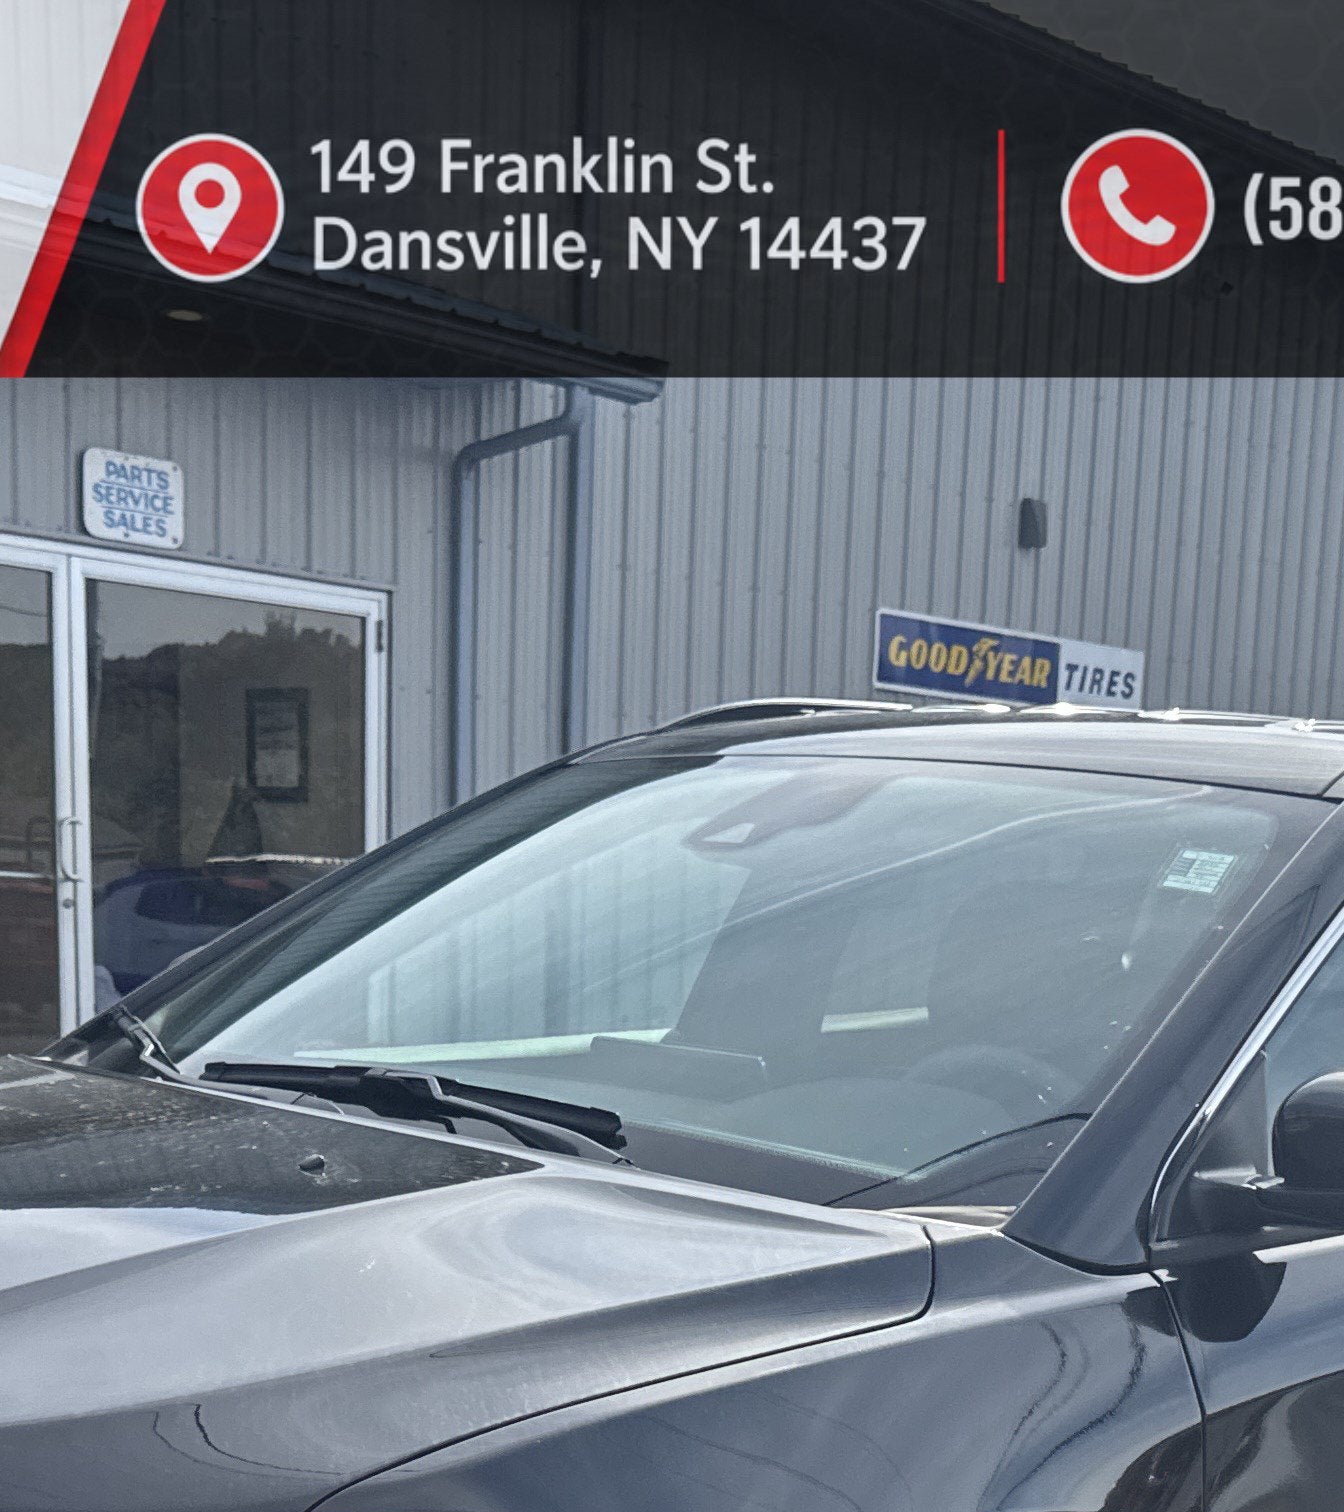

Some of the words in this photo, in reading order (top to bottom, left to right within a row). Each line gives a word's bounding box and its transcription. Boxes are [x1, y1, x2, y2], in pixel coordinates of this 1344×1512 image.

[105, 460, 170, 491] PARTS
[93, 482, 175, 515] SERVICE
[103, 509, 167, 538] SALES
[1063, 662, 1136, 700] TIRES
